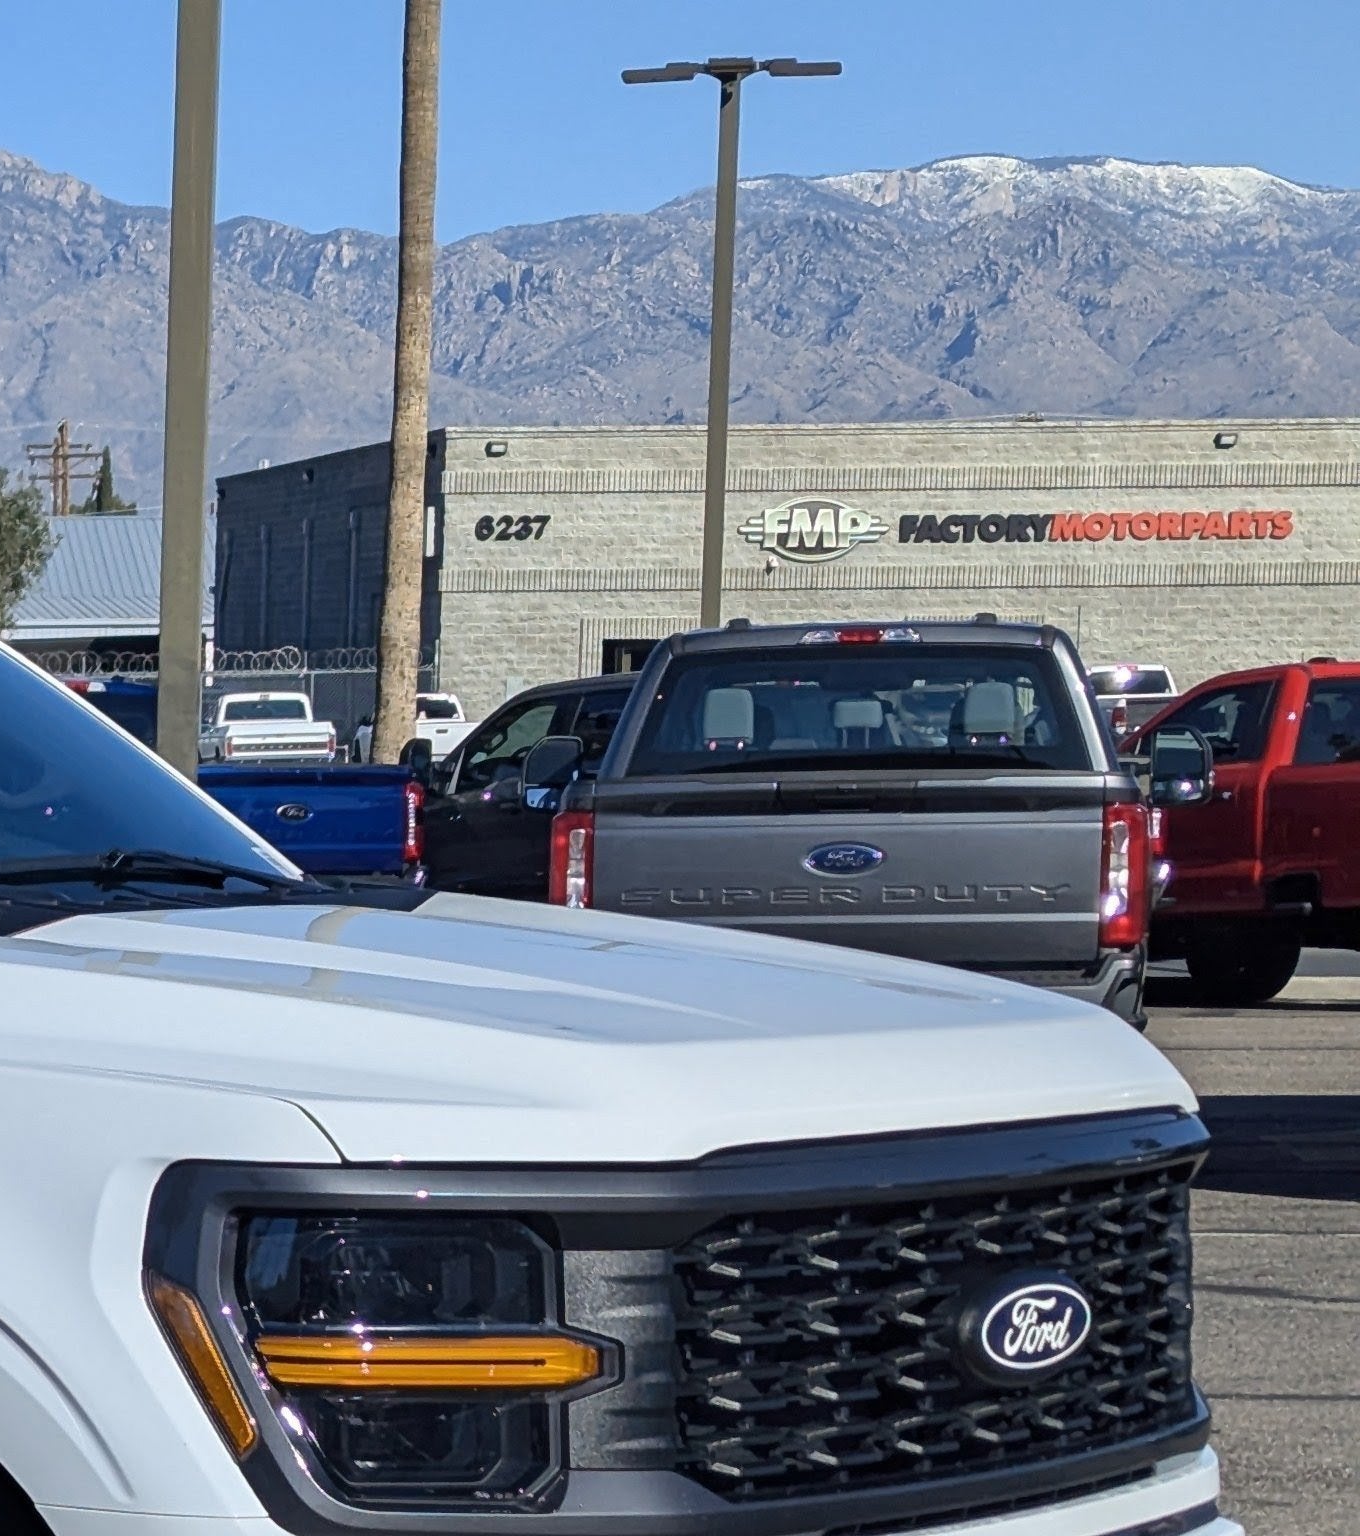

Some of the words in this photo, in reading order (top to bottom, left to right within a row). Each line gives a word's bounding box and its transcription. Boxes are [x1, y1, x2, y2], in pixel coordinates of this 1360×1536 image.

[474, 514, 551, 542] 6237
[763, 508, 873, 549] FMP
[620, 885, 863, 906] SUPER
[881, 883, 1071, 904] DUTY
[1003, 1296, 1073, 1357] Ford
